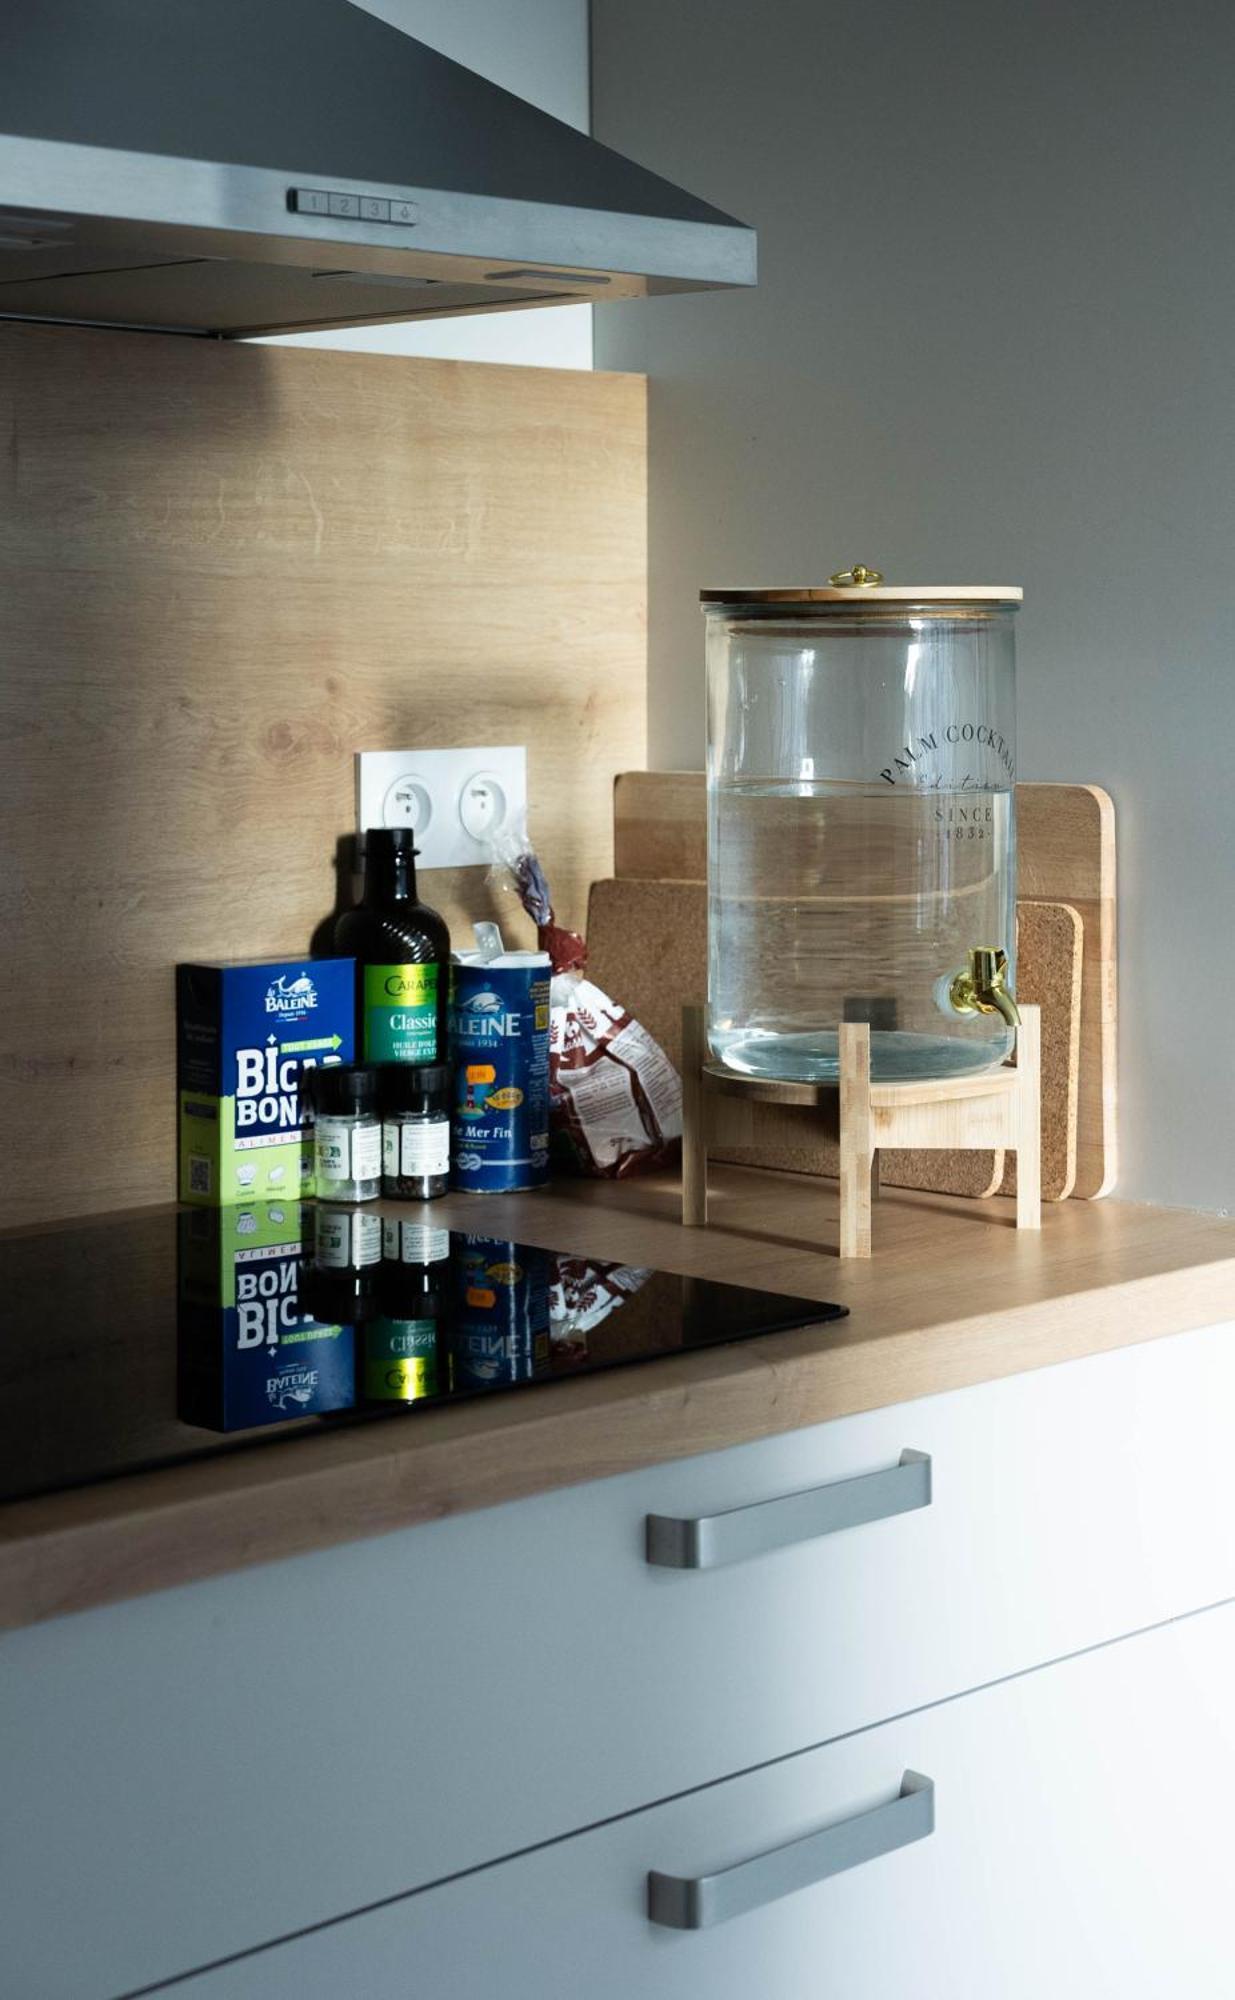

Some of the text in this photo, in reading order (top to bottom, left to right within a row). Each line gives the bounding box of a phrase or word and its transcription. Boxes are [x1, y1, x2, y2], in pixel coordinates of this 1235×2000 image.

[340, 199, 350, 214] 2
[370, 202, 380, 217] 3
[879, 733, 938, 785] PALM
[935, 807, 992, 822] SINCE
[264, 992, 318, 1013] BALEINE
[236, 1046, 342, 1098] BIC
[238, 1131, 297, 1148] ALIMEN
[465, 1125, 491, 1138] Mer
[492, 1127, 512, 1139] Fin
